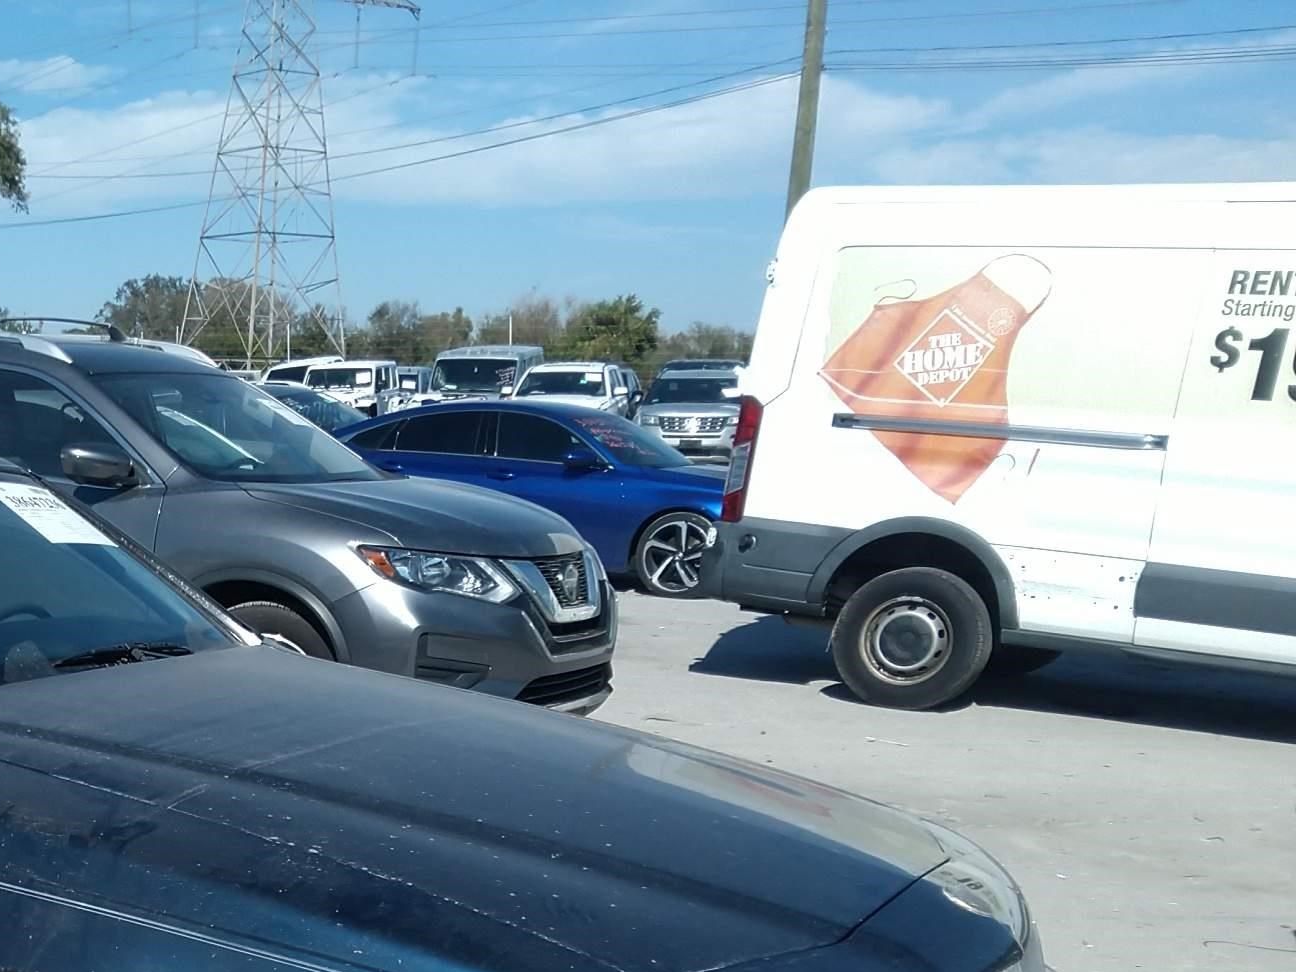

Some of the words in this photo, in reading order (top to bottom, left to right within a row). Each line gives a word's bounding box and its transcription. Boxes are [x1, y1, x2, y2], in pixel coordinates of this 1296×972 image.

[1227, 269, 1296, 296] REN
[1221, 298, 1295, 322] Starting
[928, 332, 962, 349] THE
[903, 343, 985, 374] HOME
[916, 366, 972, 386] DEPOT
